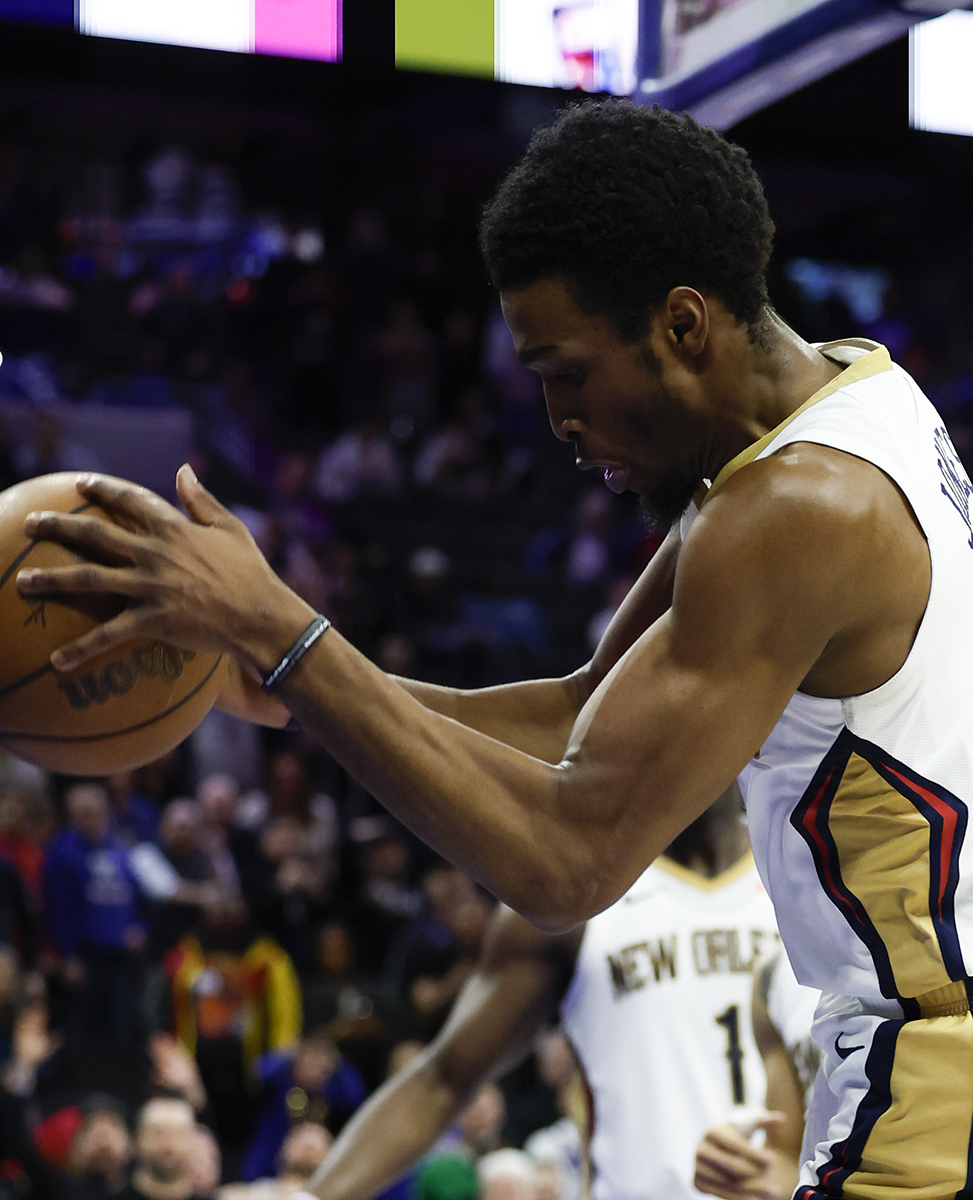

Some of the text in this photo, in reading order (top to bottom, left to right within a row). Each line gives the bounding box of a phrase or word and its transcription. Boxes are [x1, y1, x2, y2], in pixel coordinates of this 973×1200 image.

[57, 641, 196, 710] lson
[607, 928, 783, 1002] NEW ORLE
[715, 1003, 745, 1106] 1
